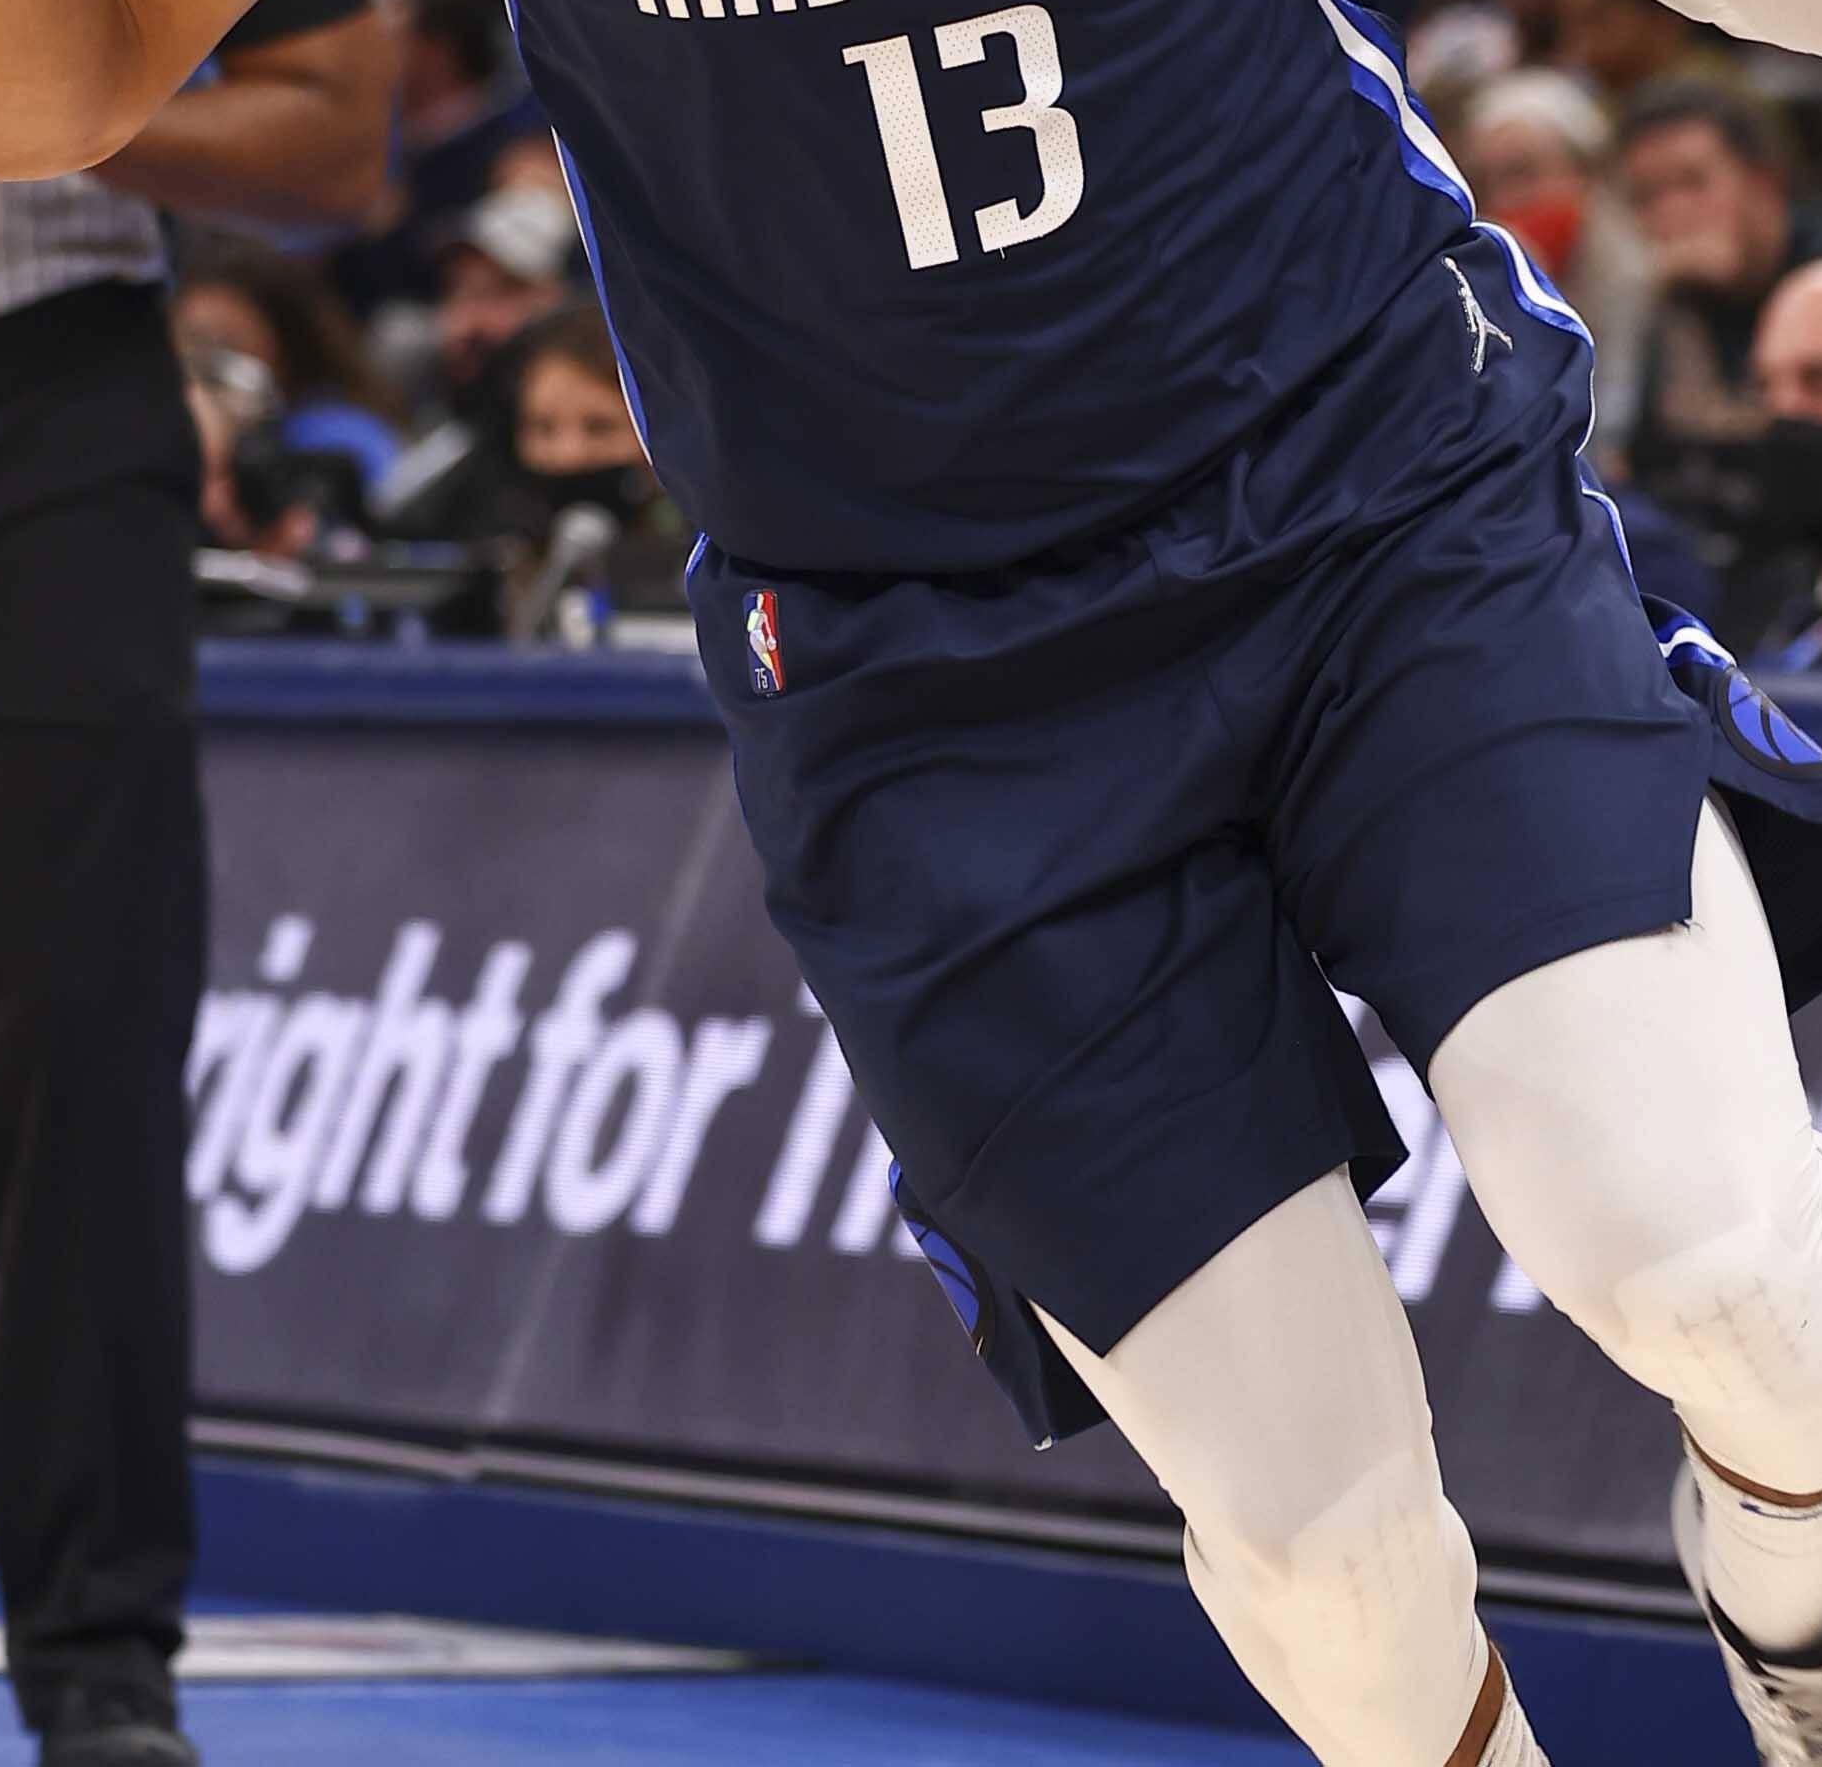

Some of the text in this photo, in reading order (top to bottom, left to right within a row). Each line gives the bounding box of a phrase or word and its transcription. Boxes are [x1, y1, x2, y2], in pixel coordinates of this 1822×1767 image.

[841, 3, 1085, 271] 13
[754, 667, 769, 690] 75
[481, 926, 773, 1238] for
